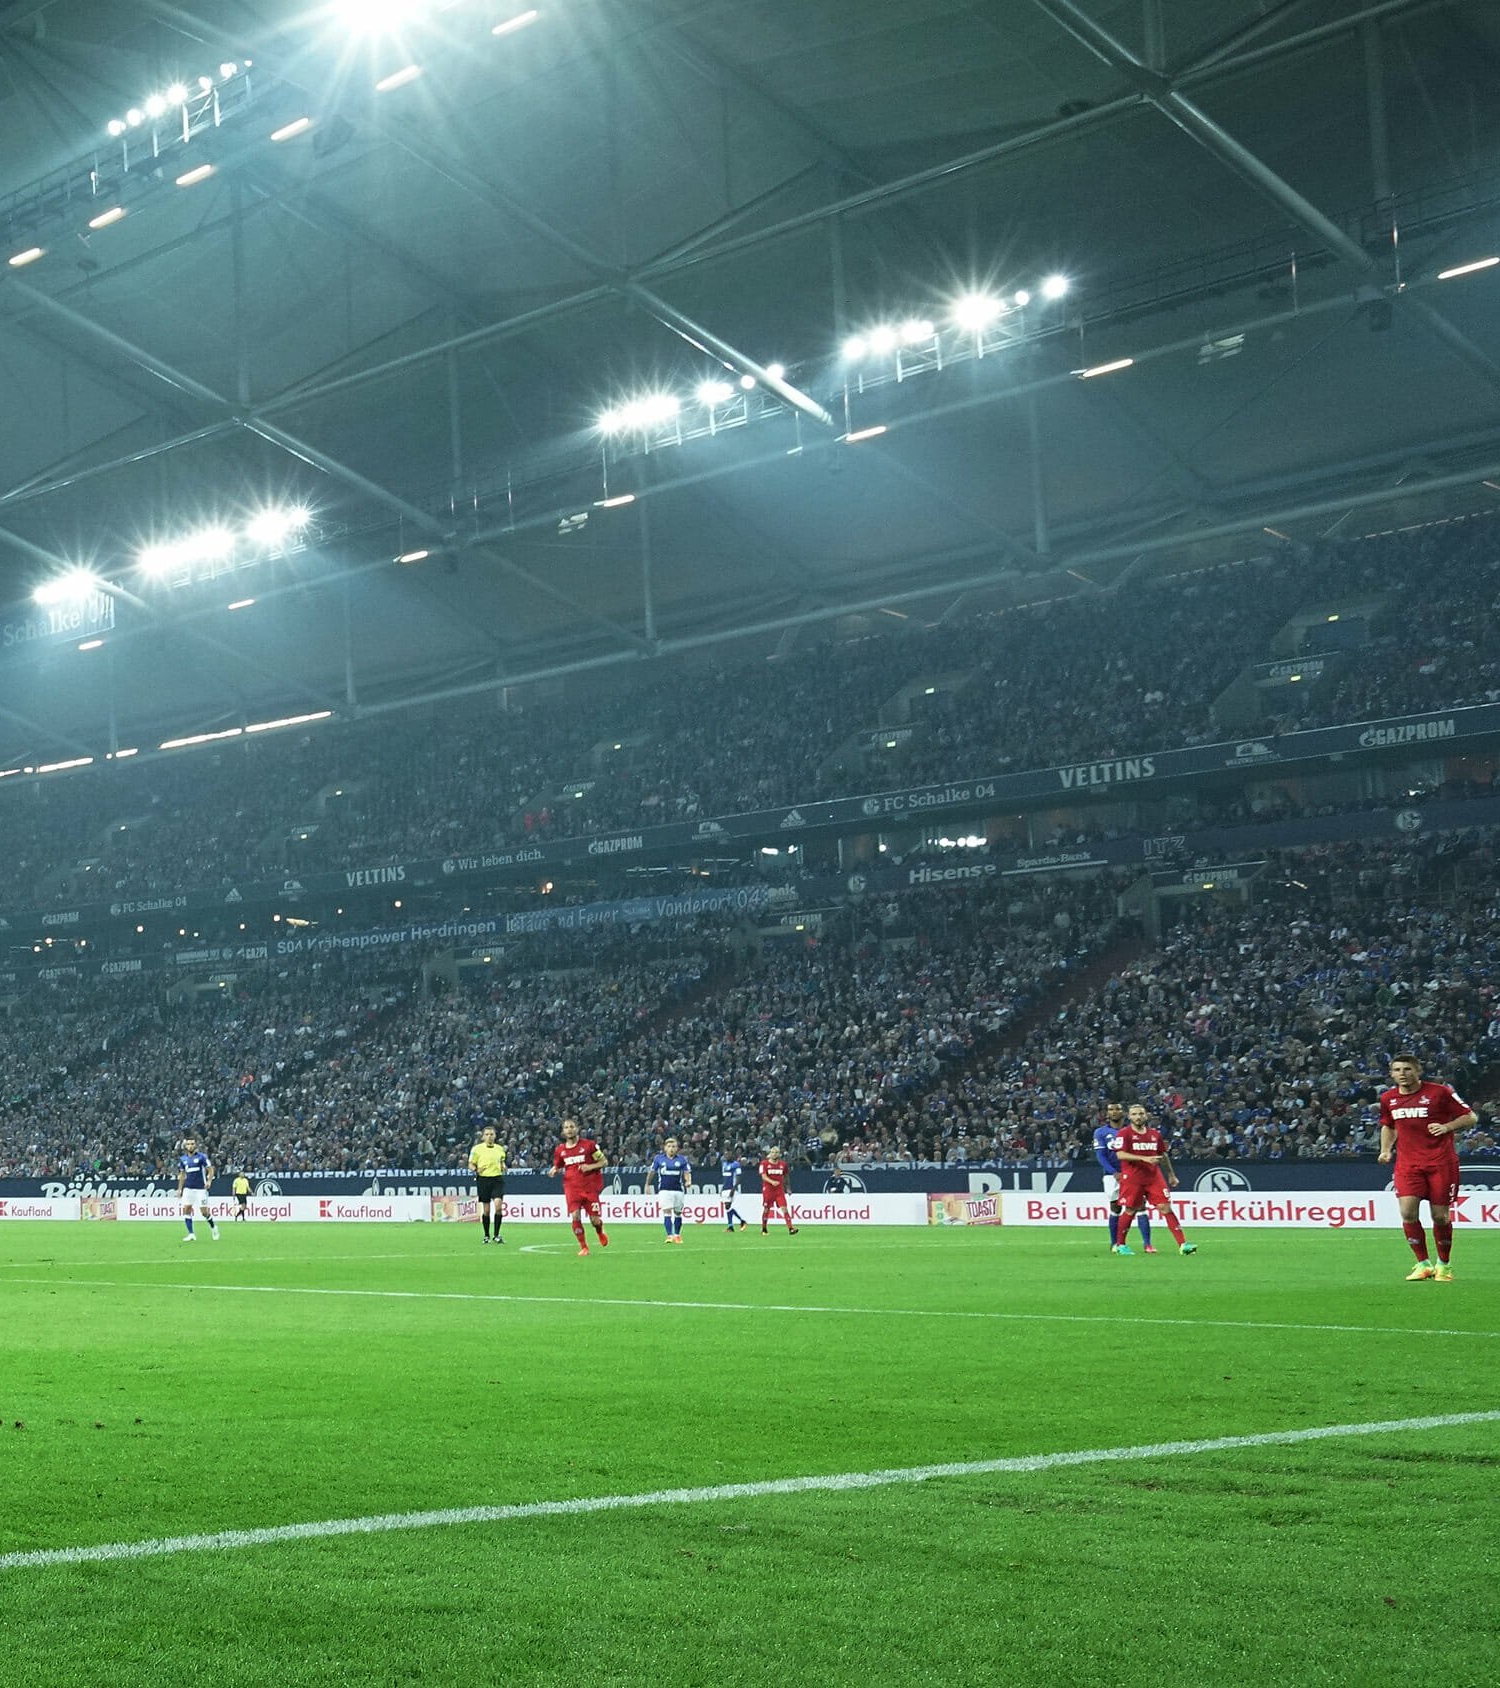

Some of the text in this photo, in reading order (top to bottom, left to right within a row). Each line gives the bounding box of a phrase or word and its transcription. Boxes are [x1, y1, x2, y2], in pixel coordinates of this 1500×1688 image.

[1376, 719, 1455, 745] GAZPROM
[1059, 757, 1156, 788] VELTINS
[884, 783, 996, 811] FC Schalke 04
[598, 836, 642, 854] GAZPROM
[458, 849, 545, 871] Wir leben dich.
[346, 866, 406, 887] VELTINS
[909, 864, 997, 885] Hisense
[123, 902, 134, 913] FC
[137, 900, 173, 912] Schalke
[1132, 1142, 1157, 1150] REWE
[12, 1206, 52, 1216] Kaufland
[129, 1203, 148, 1216] Bei
[153, 1206, 175, 1216] uns
[337, 1205, 392, 1217] Kaufland
[501, 1202, 561, 1218] Bei uns
[791, 1205, 870, 1220] Kaufland
[966, 1198, 997, 1218] TOASTY
[1027, 1201, 1108, 1221] Bei un
[1171, 1201, 1376, 1229] Tiefkühlregal
